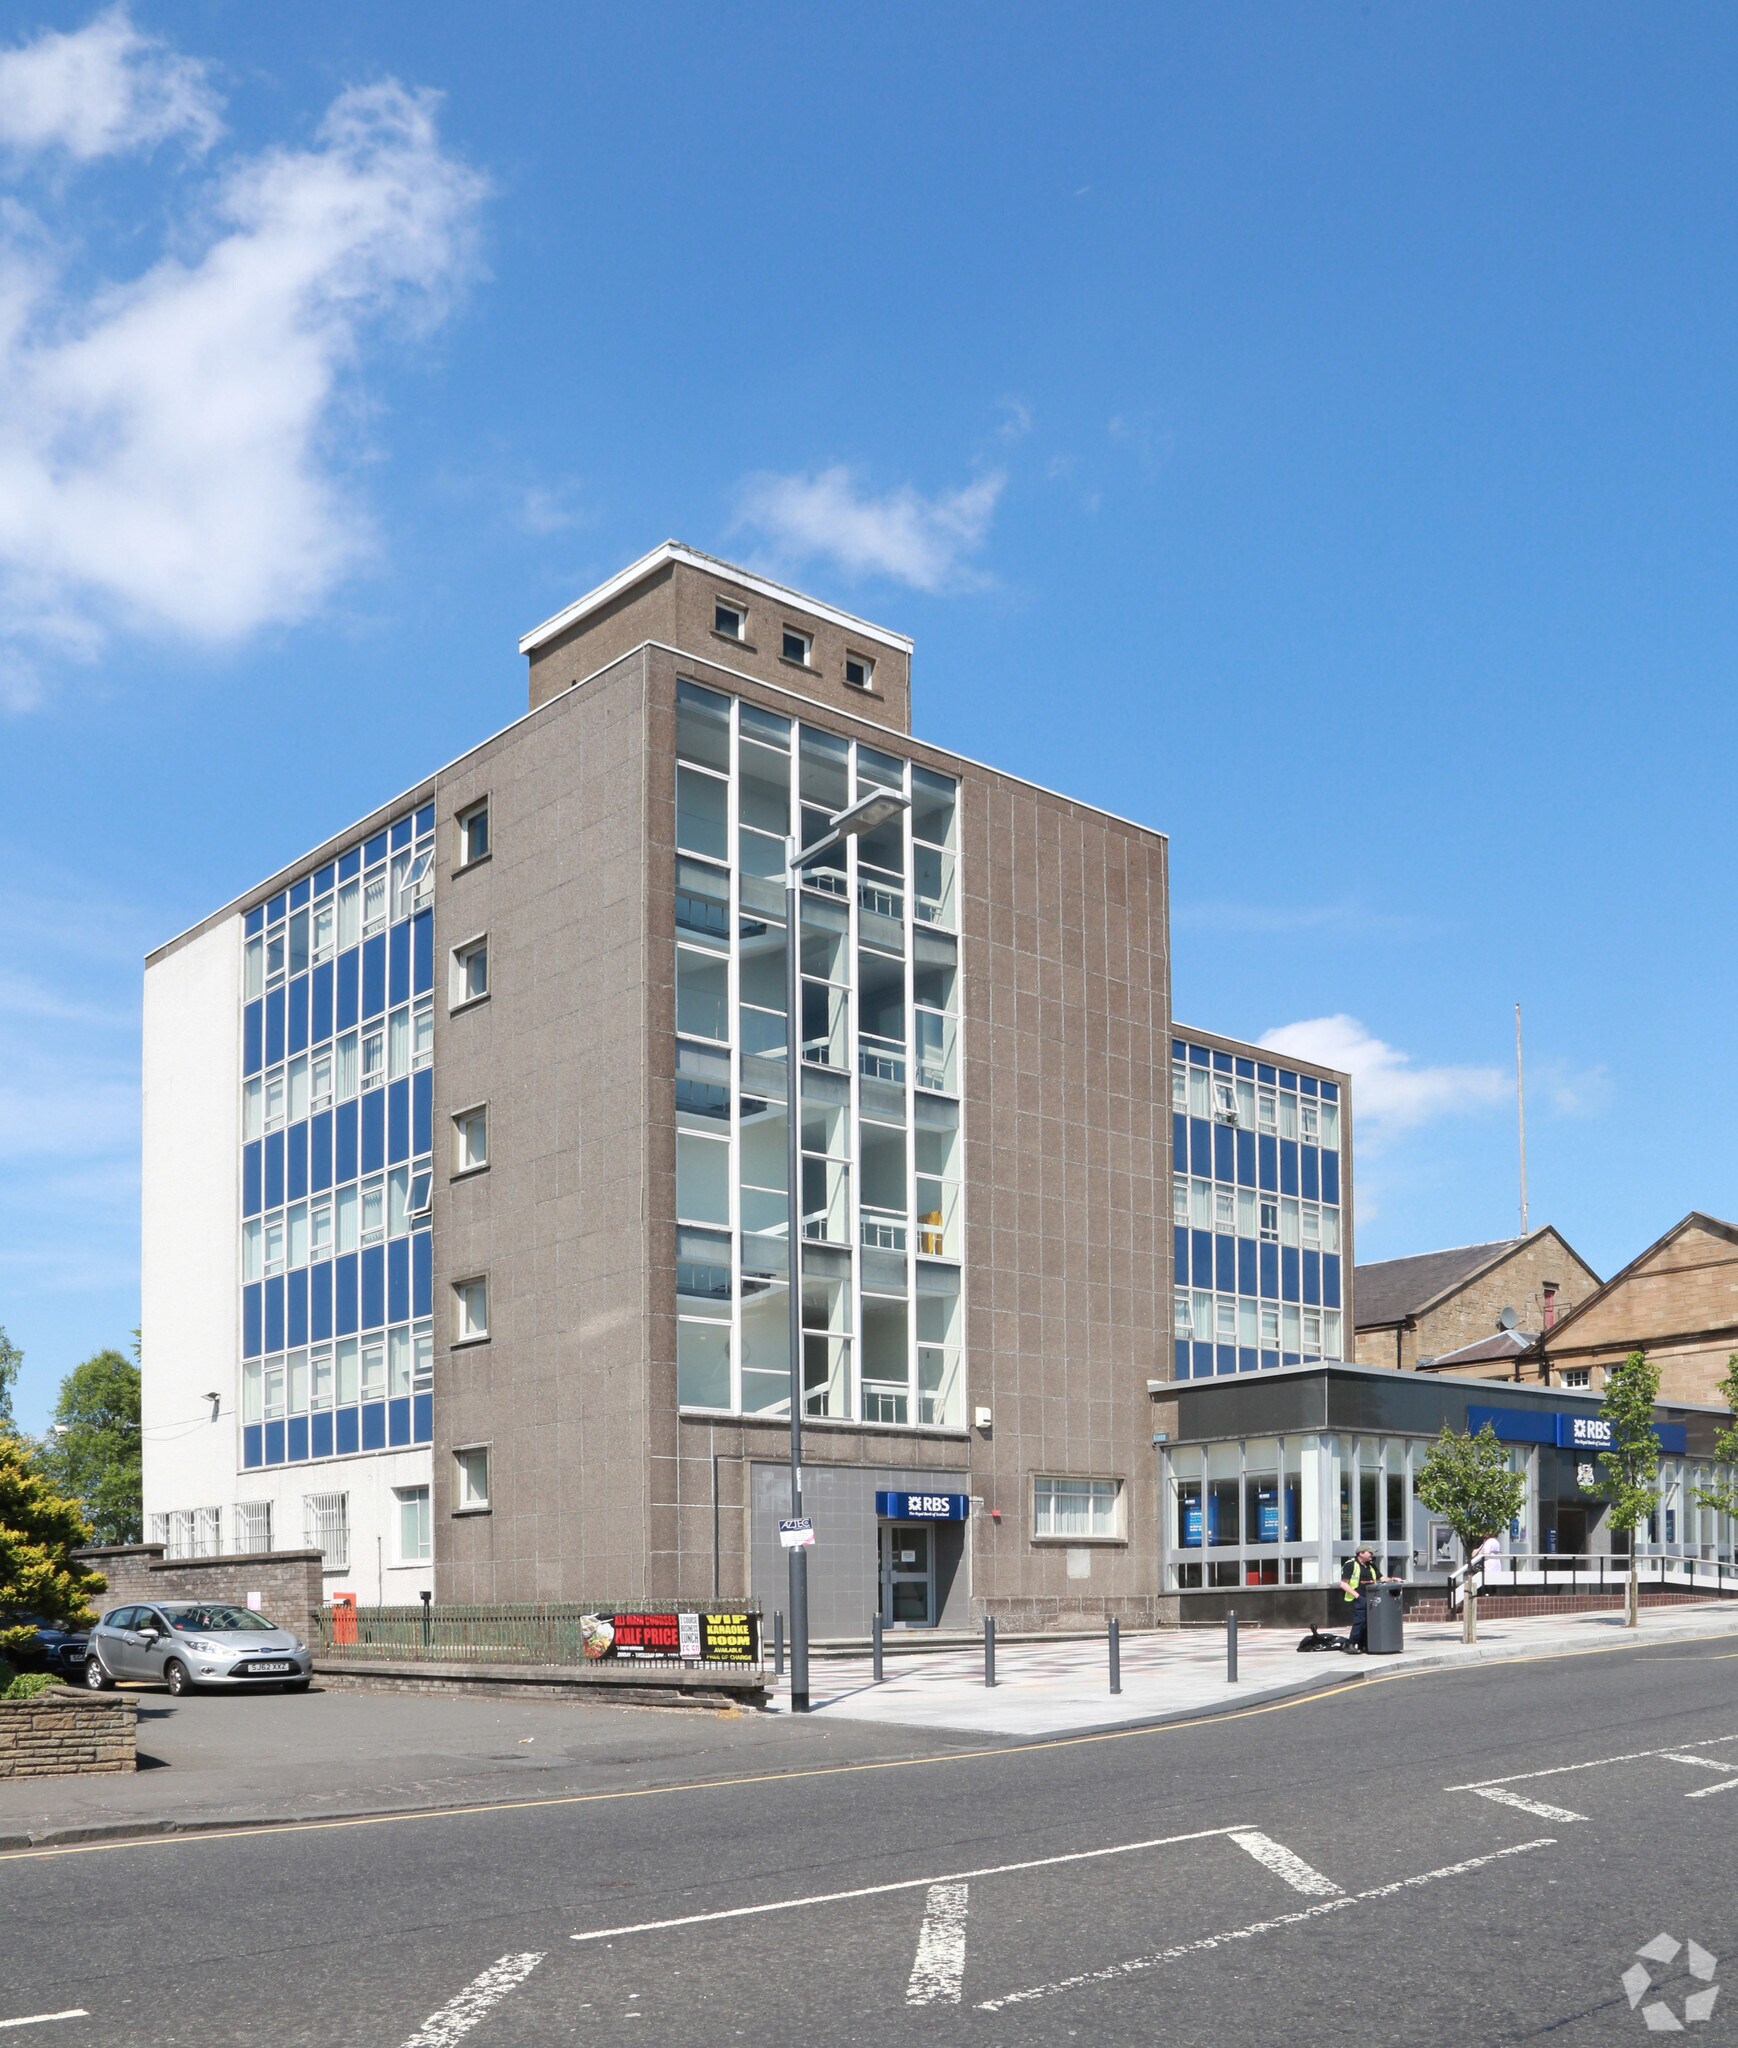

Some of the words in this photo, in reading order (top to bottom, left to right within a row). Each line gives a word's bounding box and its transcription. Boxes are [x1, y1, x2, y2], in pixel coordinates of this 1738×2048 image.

[1587, 1420, 1611, 1440] RBS
[923, 1497, 950, 1512] RBS
[781, 1518, 810, 1529] AZTEC
[645, 1615, 677, 1626] COURSES
[706, 1614, 747, 1624] VIP
[707, 1625, 749, 1635] KARAOKE
[643, 1627, 679, 1646] PRICE
[681, 1633, 699, 1644] LUNCH
[707, 1636, 750, 1646] ROOM
